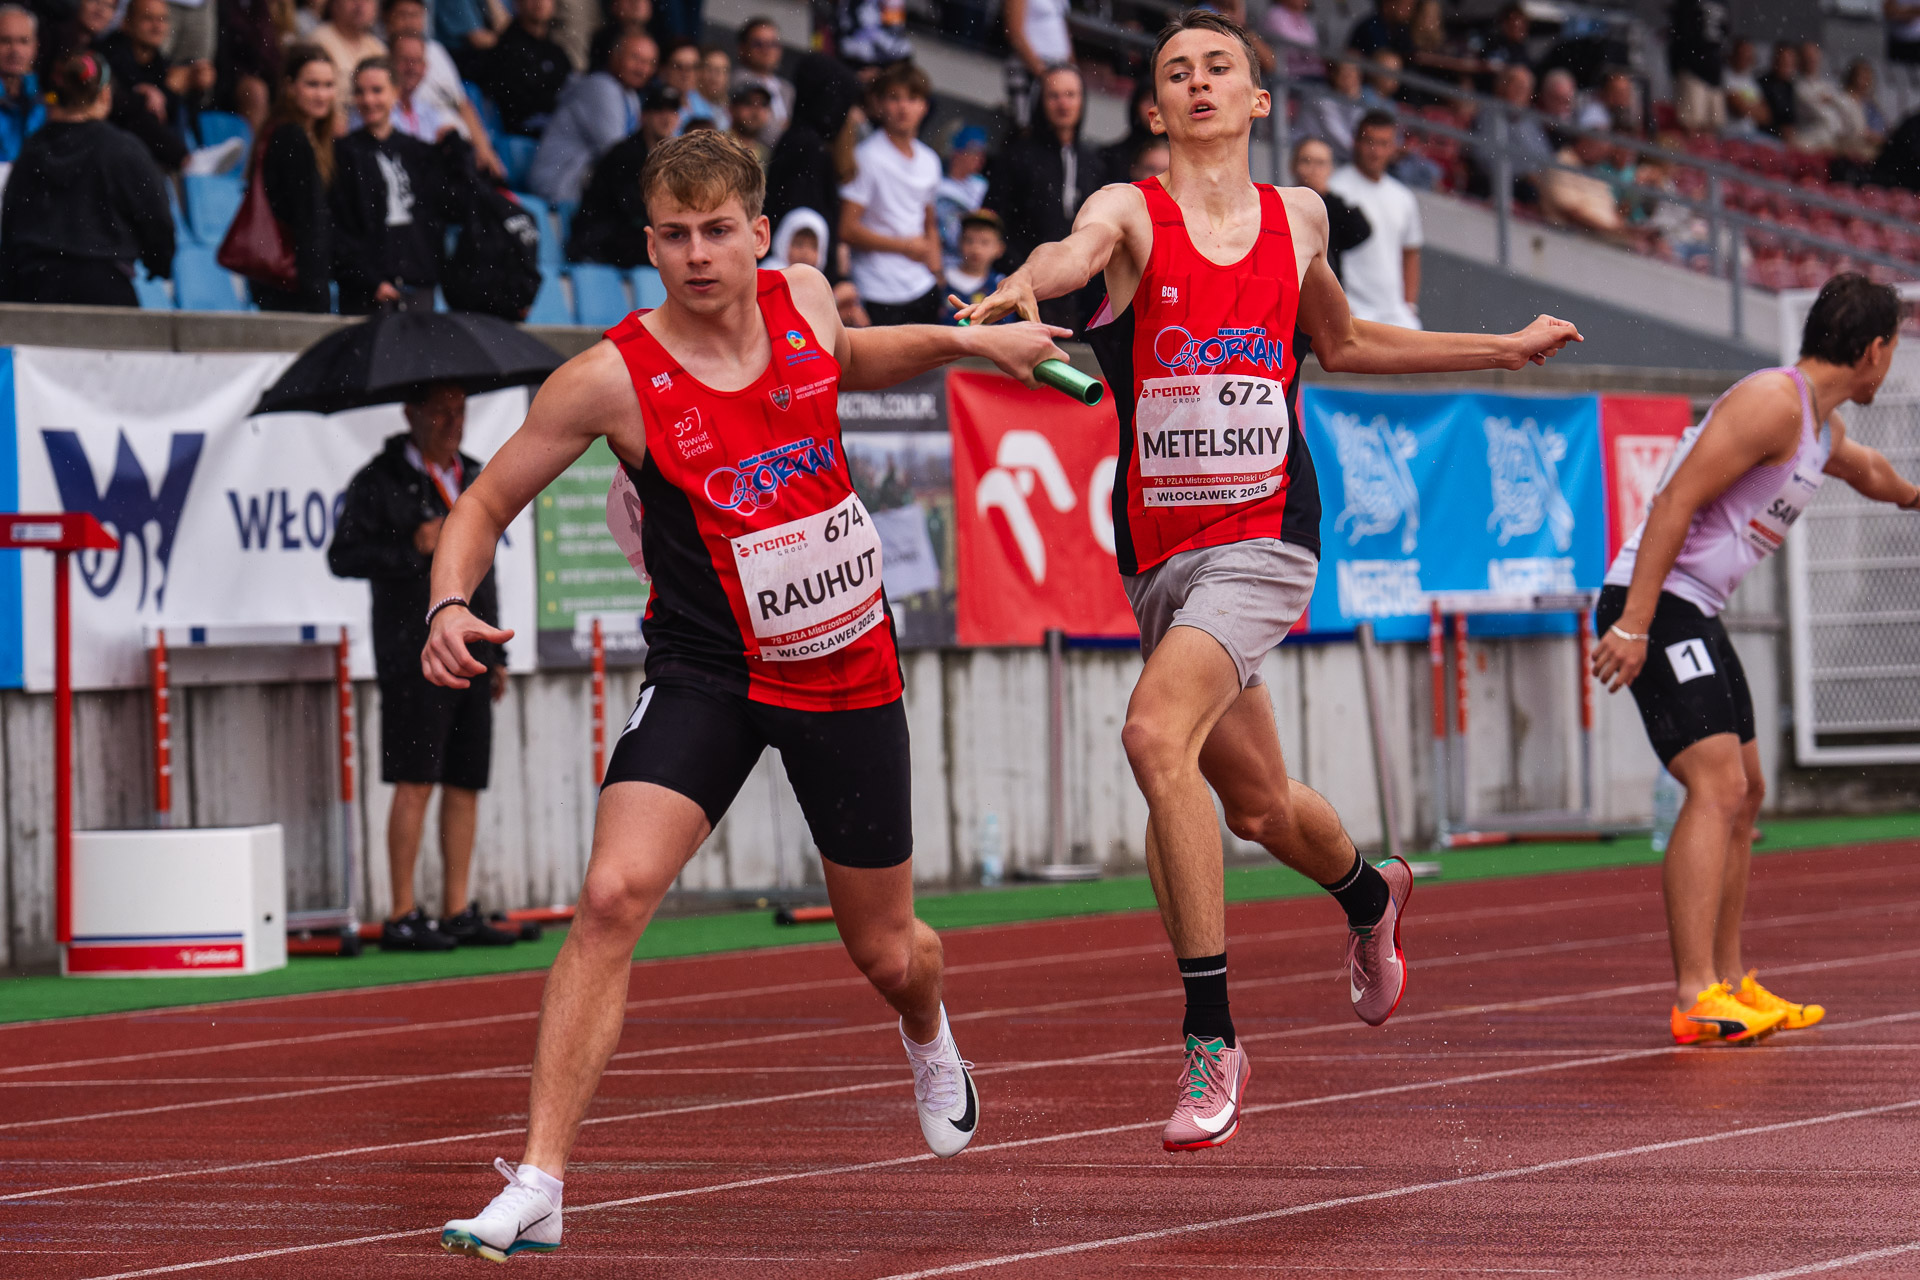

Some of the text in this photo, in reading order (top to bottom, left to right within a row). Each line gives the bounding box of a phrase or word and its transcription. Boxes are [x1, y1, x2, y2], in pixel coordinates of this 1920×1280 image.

[1162, 286, 1178, 298] BCM
[1198, 336, 1283, 371] ORKAN
[650, 372, 671, 388] BCM
[1218, 382, 1273, 406] 672
[677, 431, 709, 449] Powiat
[682, 440, 714, 460] Średzki
[1142, 427, 1284, 459] METELSKIY
[752, 438, 837, 492] ORKAN
[1157, 483, 1267, 501] WŁOCŁAWEK 2025
[1167, 477, 1184, 485] PZLA
[1185, 475, 1232, 484] Mistrzostwa
[1233, 474, 1257, 483] Polski
[824, 502, 864, 543] 674
[777, 543, 809, 557] GROUP
[757, 547, 876, 620] RAUHUT
[771, 637, 785, 645] 79.
[785, 631, 807, 643] PZLA
[807, 614, 852, 637] Mistrzostwa
[777, 610, 876, 658] WŁOCŁAWEK 2025
[1682, 645, 1702, 671] 1
